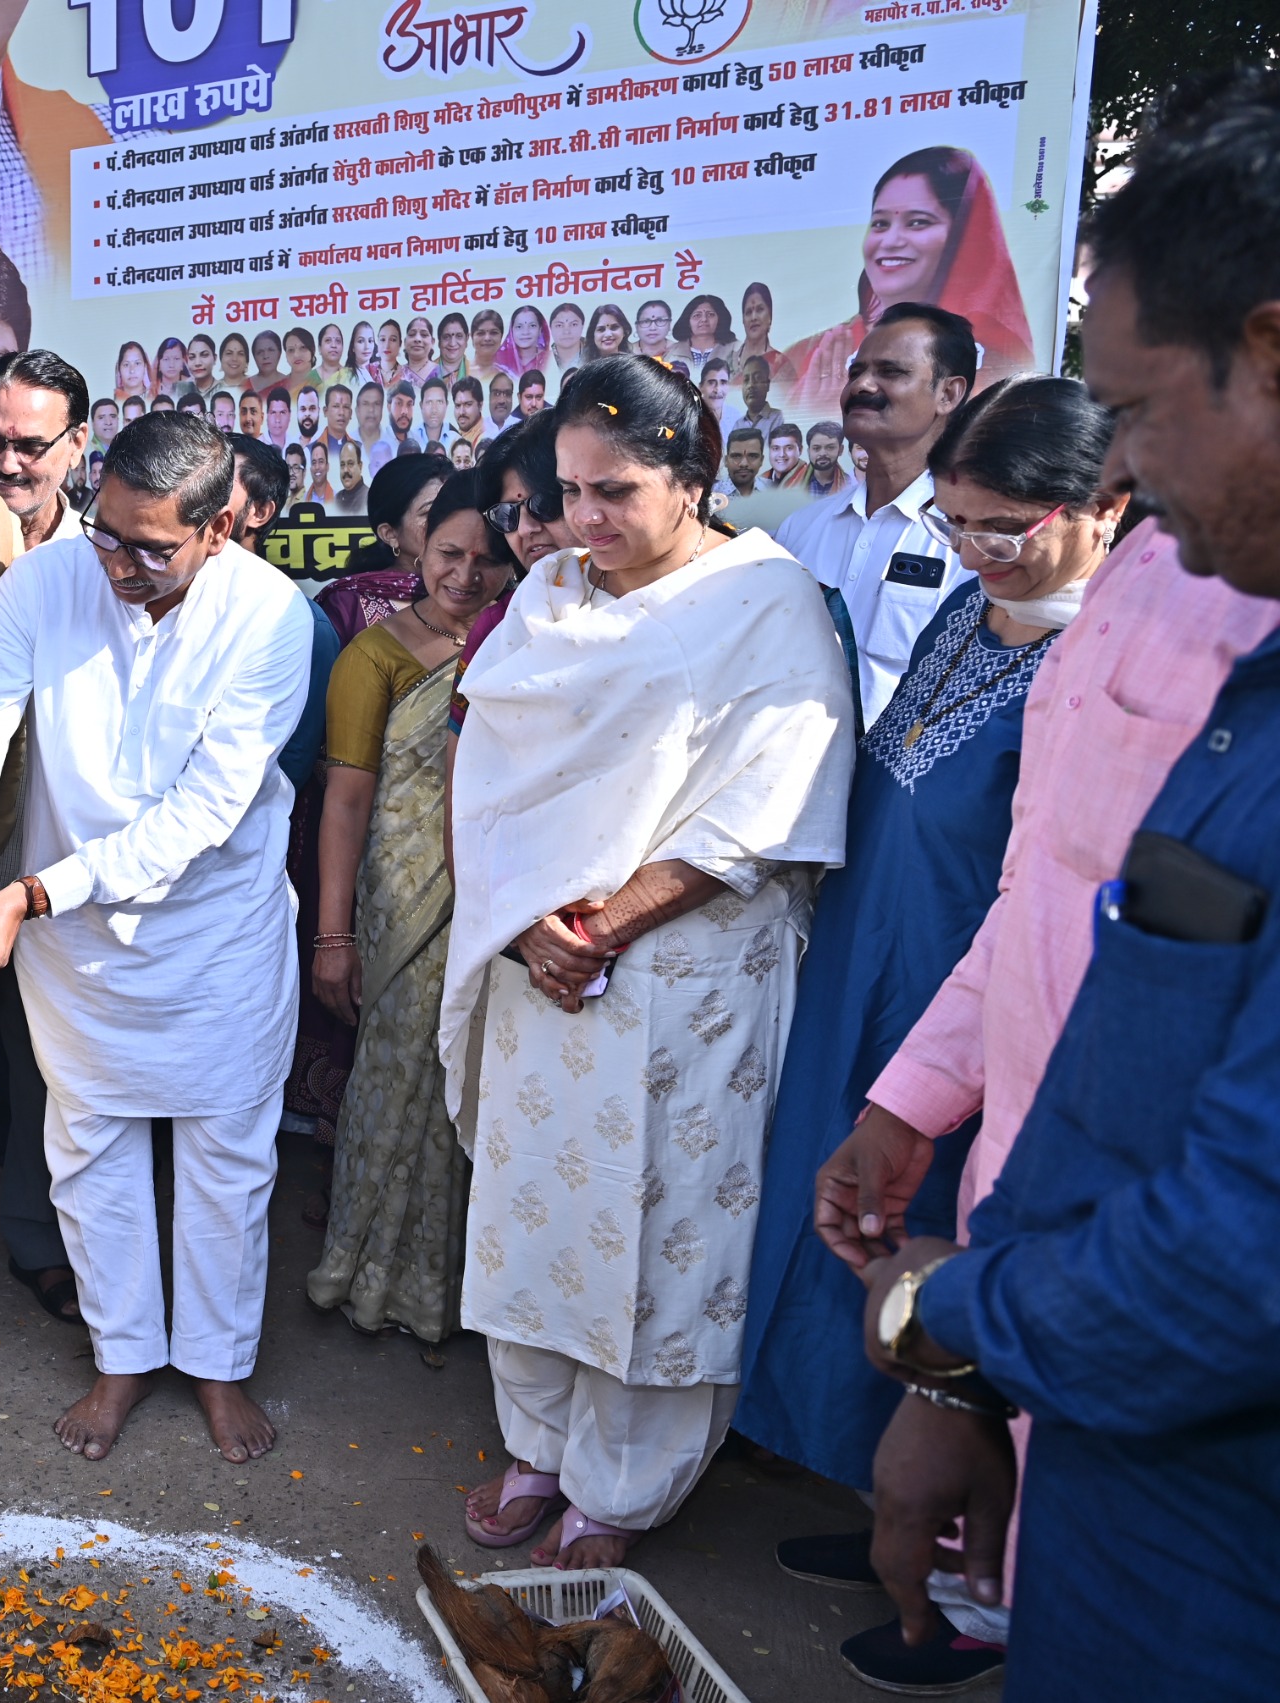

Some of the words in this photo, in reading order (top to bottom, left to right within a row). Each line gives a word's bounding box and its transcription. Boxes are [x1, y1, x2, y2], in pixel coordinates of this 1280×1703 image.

[383, 0, 586, 77] आभार
[864, 2, 908, 23] महापौर
[113, 86, 189, 130] लाख
[194, 64, 272, 117] रुपये
[189, 137, 246, 160] उपाध्याय
[250, 128, 275, 151] वार्ड
[280, 121, 329, 147] अंतर्गत
[333, 112, 390, 140] सरस्वती
[394, 110, 429, 134] शिशु
[434, 102, 473, 125] मंदिर
[477, 92, 562, 120] रोहणीपुरम
[567, 84, 583, 107] में
[587, 77, 679, 105] डामरीकरण
[735, 62, 763, 91] हेतु
[769, 61, 796, 82] 50
[804, 53, 854, 77] लाख
[859, 43, 926, 71] स्वीकृत
[188, 178, 246, 200] उपाध्याय
[250, 169, 275, 191] वार्ड
[279, 163, 329, 188] अंतर्गत
[332, 157, 371, 186] सेंचुरी
[375, 149, 435, 175] कालोनी
[438, 146, 455, 168] के
[459, 146, 486, 166] एक
[491, 138, 524, 162] ओर
[625, 123, 671, 146] नाला
[676, 111, 740, 140] निर्माण
[744, 103, 785, 131] कार्य
[789, 102, 818, 131] हेतु
[824, 96, 892, 123] 31.81
[900, 90, 952, 114] लाख
[958, 80, 1028, 108] स्वीकृत
[188, 218, 245, 239] उपाध्याय
[250, 210, 274, 231] वार्ड
[279, 204, 328, 230] अंतर्गत
[332, 197, 388, 223] सरस्वती
[393, 195, 427, 220] शिशु
[432, 189, 471, 211] मंदिर
[475, 184, 491, 207] में
[494, 182, 528, 205] हॉल
[533, 174, 591, 201] निर्माण
[595, 168, 633, 194] कार्य
[637, 167, 664, 195] हेतु
[671, 166, 695, 186] 10
[702, 160, 750, 183] लाख
[754, 152, 817, 180] स्वीकृत
[188, 258, 245, 278] उपाध्याय
[249, 250, 274, 272] वार्ड
[278, 248, 292, 269] में
[298, 244, 362, 267] कार्यालय
[367, 242, 403, 260] भवन
[464, 227, 499, 251] कार्य
[504, 226, 528, 253] हेतु
[535, 226, 556, 244] 10
[563, 221, 607, 241] लाख
[611, 213, 669, 240] स्वीकृत
[192, 293, 215, 325] में
[225, 298, 279, 323] आप
[289, 282, 348, 317] सभी
[358, 287, 400, 312] का
[410, 269, 506, 312] हार्दिक
[515, 258, 664, 299] अभिनंदन
[675, 249, 703, 290] है
[263, 513, 377, 572] चंद्र
